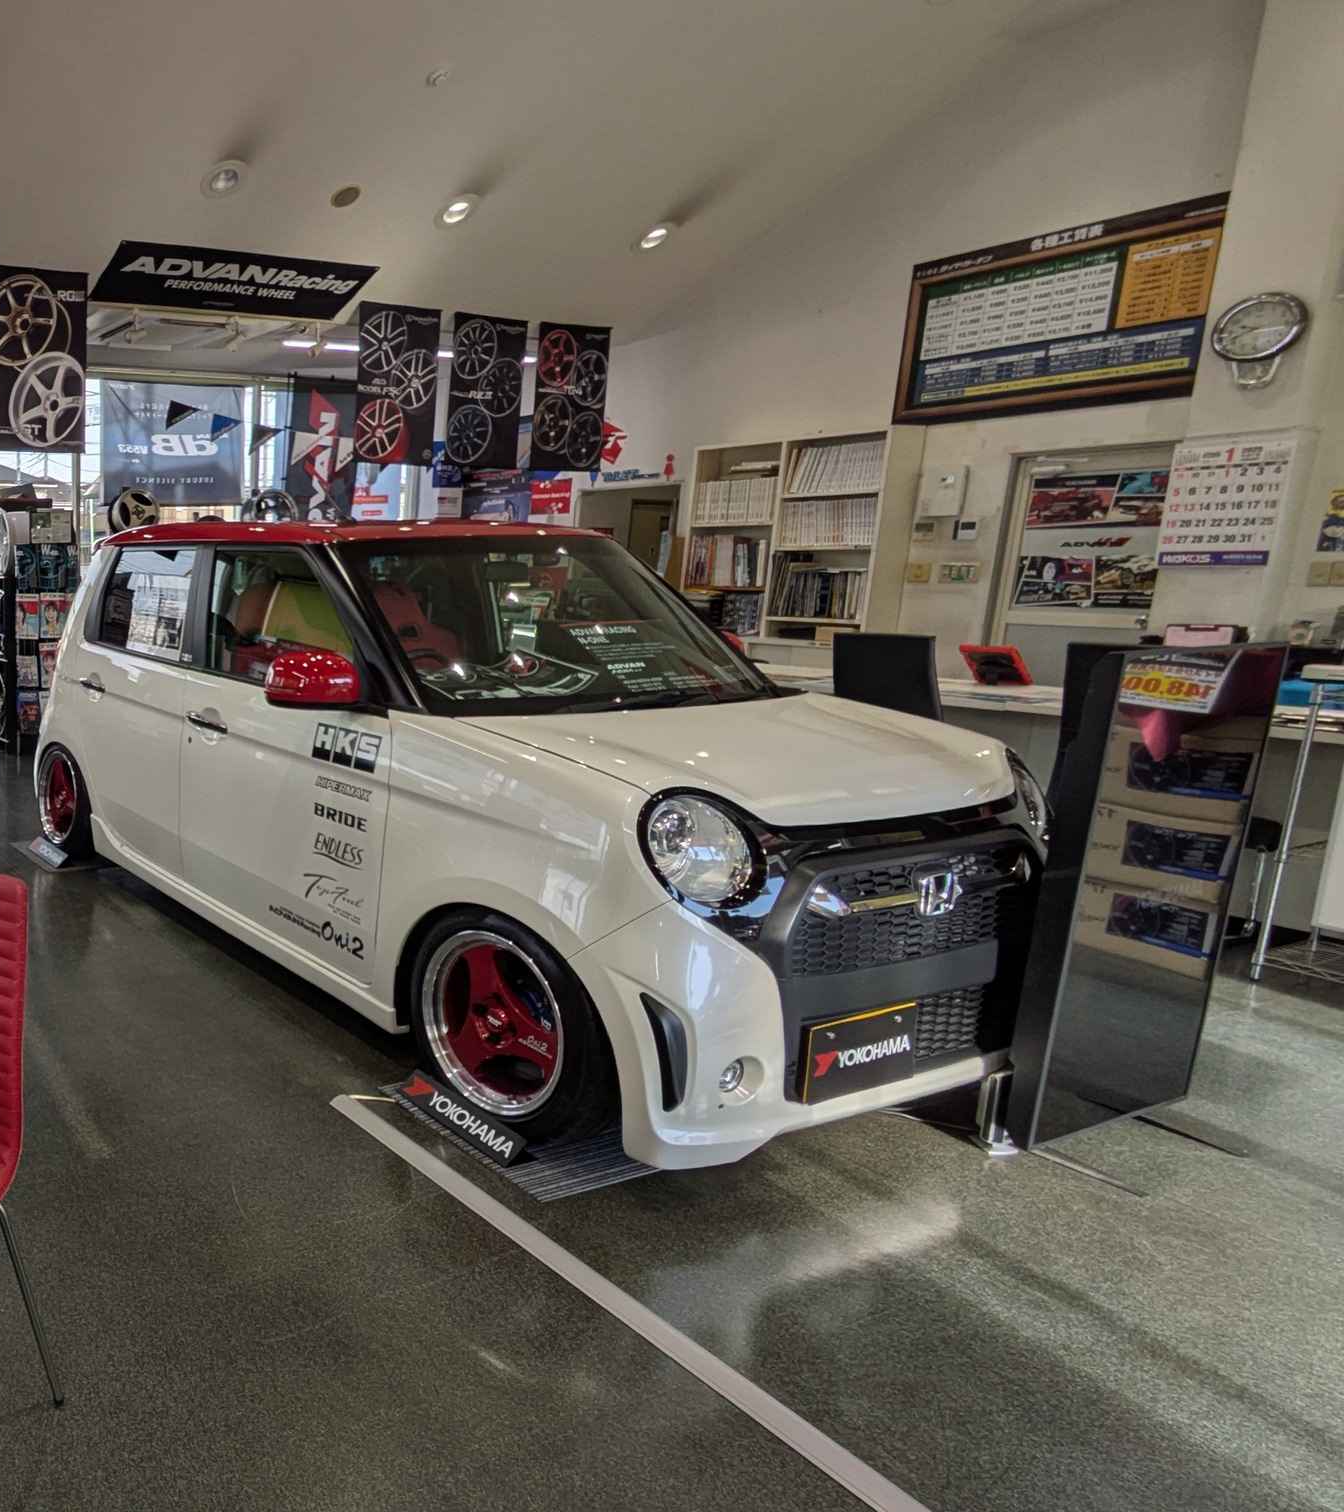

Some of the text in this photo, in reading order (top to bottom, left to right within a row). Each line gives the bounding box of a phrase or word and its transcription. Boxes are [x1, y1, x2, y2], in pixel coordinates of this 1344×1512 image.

[164, 278, 296, 300] PERFORMANCE WHEEL
[1226, 448, 1235, 462] 1
[1240, 468, 1248, 476] 2
[1256, 467, 1264, 475] 3
[1273, 466, 1282, 474] 4
[1173, 488, 1180, 496] 5
[1188, 487, 1196, 495] 6
[1204, 486, 1212, 494] 7
[1236, 485, 1244, 493] 9
[1251, 484, 1263, 492] 10
[1268, 483, 1279, 491] 11
[1170, 504, 1179, 512] 12
[1200, 503, 1211, 511] 14
[1248, 501, 1260, 509] 17
[1210, 519, 1223, 527] 22
[1226, 518, 1239, 526] 23
[1243, 518, 1256, 526] 24
[1191, 535, 1203, 543] 28
[1222, 534, 1235, 542] 30
[1240, 534, 1252, 542] 31
[313, 724, 382, 770] HKS
[314, 801, 368, 833] BRIDE
[313, 832, 364, 867] ENDLESS
[837, 1033, 911, 1070] YOKOHAMA
[427, 1089, 515, 1160] YOKOHAMA
